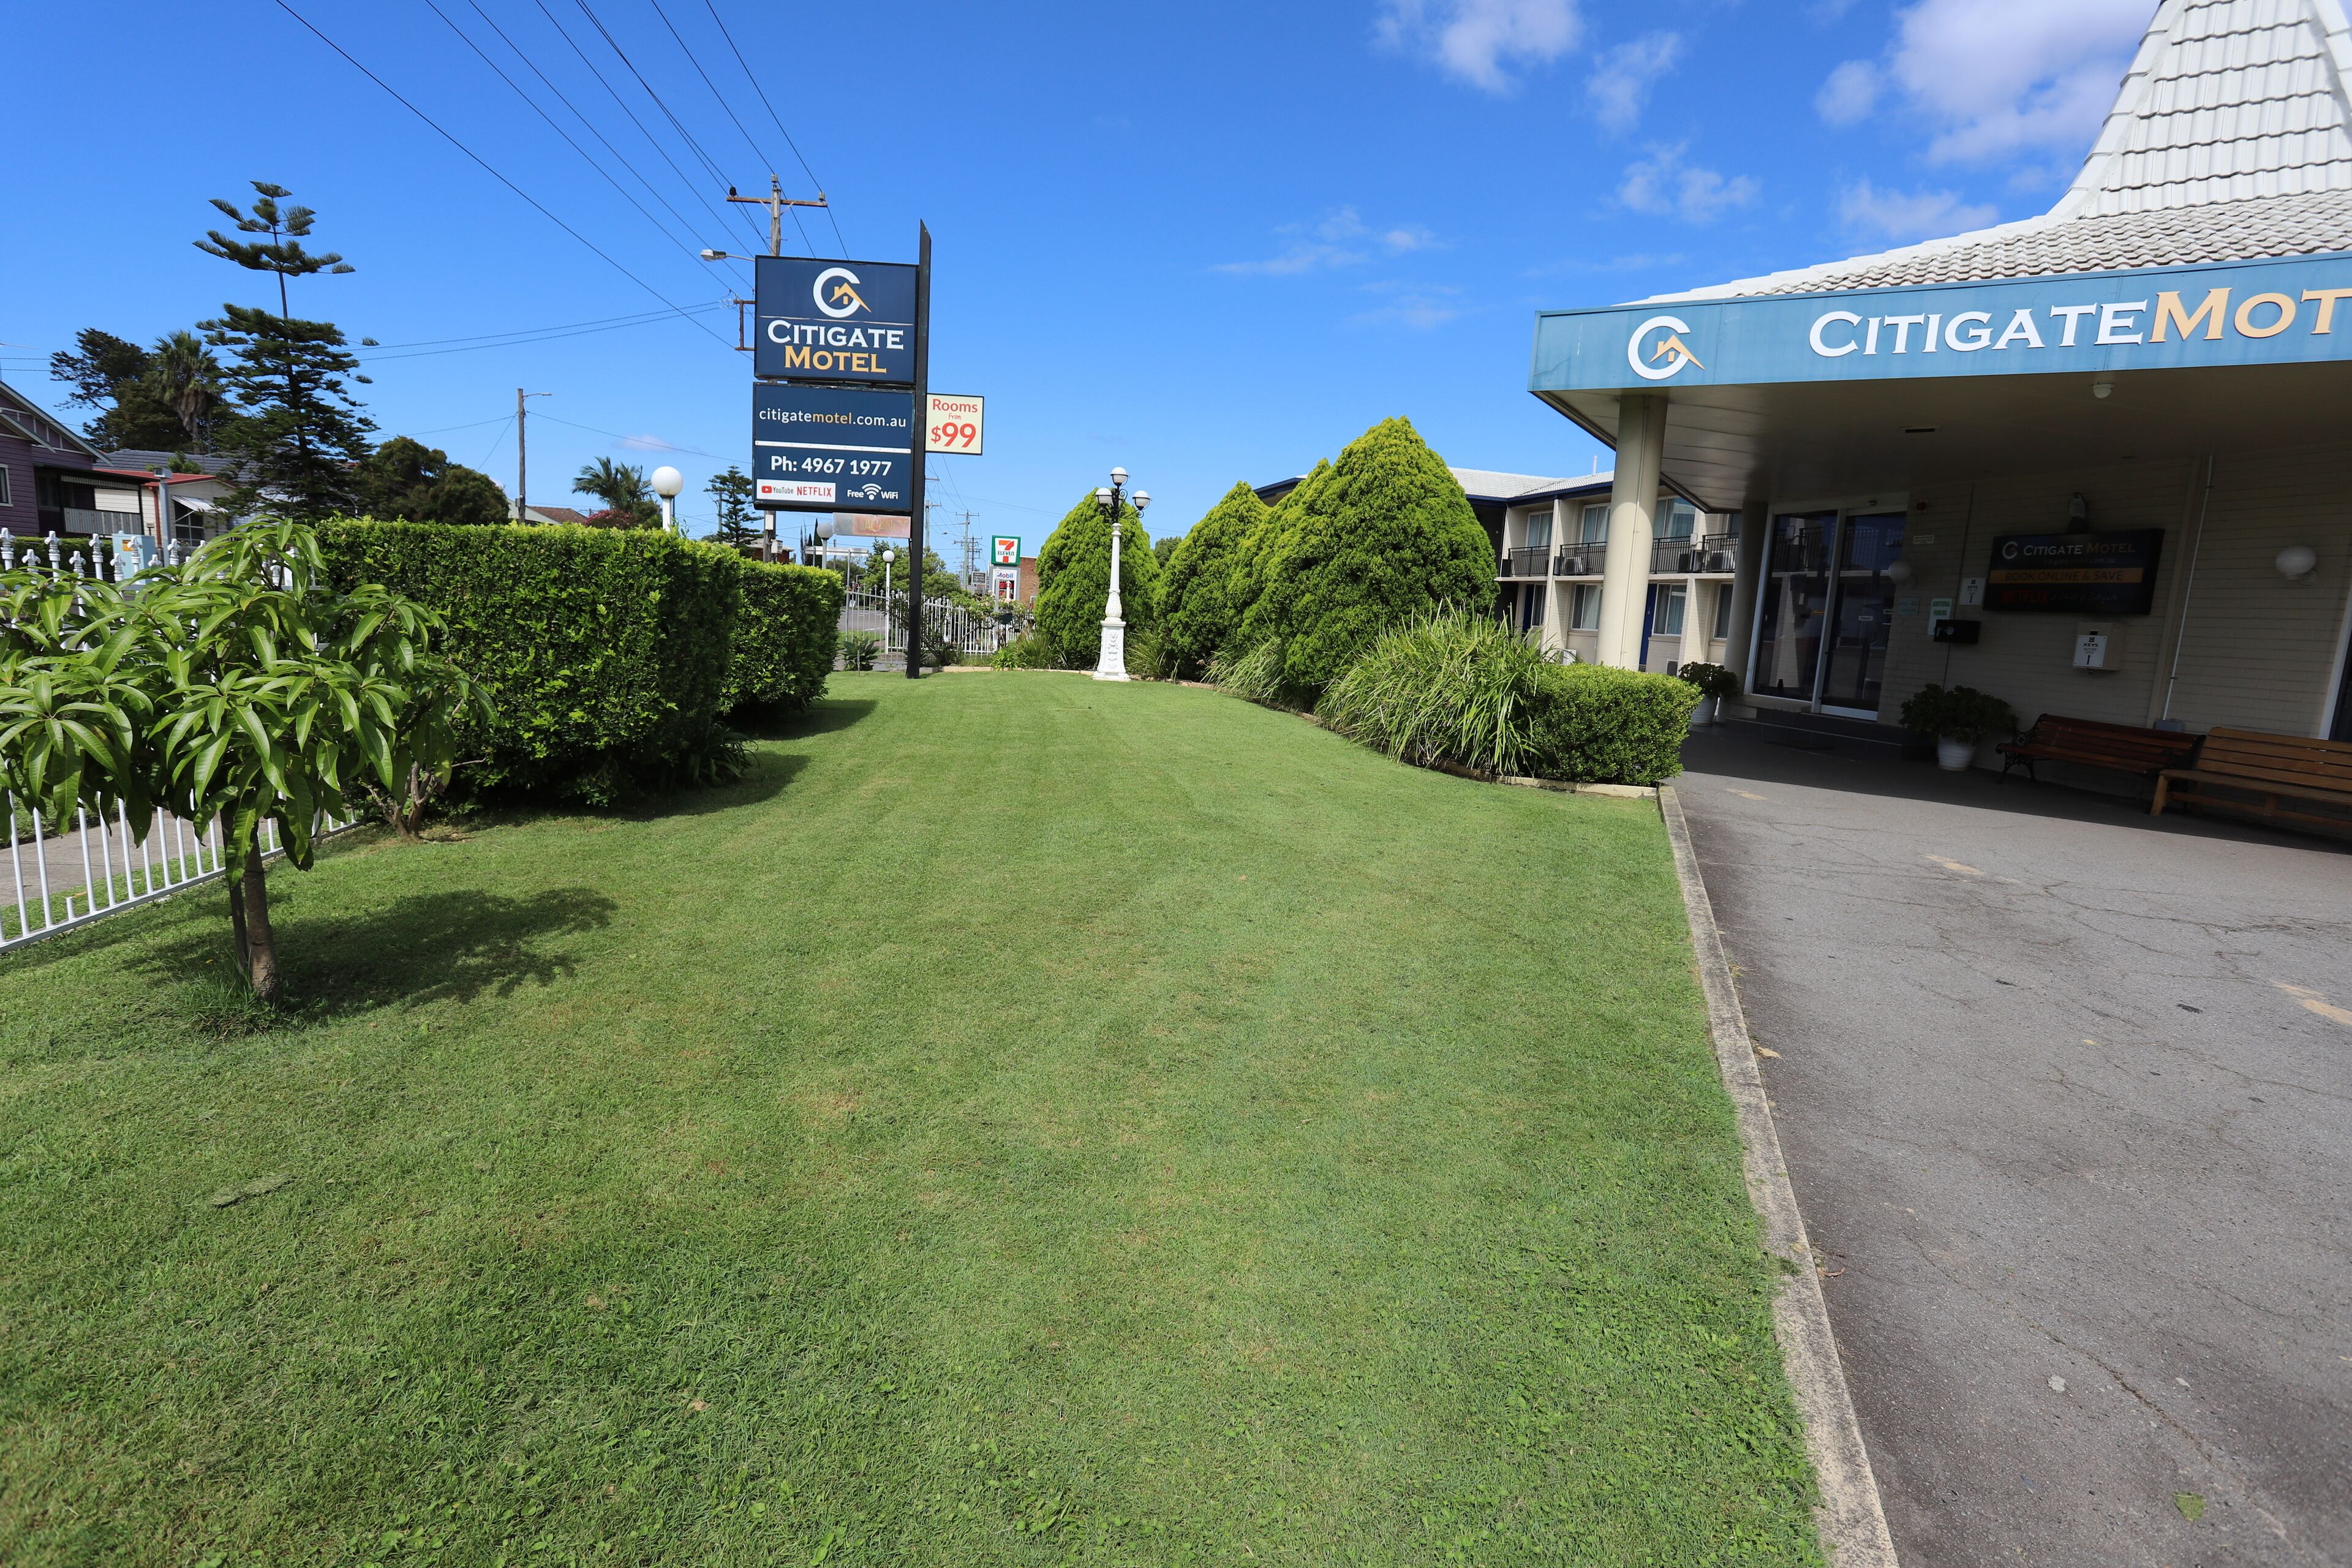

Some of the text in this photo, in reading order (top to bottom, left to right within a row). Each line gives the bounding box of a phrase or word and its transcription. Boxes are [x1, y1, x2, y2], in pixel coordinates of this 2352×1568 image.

[767, 320, 904, 350] CITIGATE
[785, 345, 887, 374] MOTEL
[932, 398, 978, 413] Rooms
[759, 408, 907, 427] citigatemotel.com.au
[930, 422, 977, 448] $99
[771, 456, 892, 476] Ph: 4967 1977
[797, 486, 832, 497] NETFLIX
[847, 489, 864, 498] Free
[2024, 545, 2083, 556] CITIGATE
[2087, 542, 2136, 554] MOTEL
[2005, 572, 2035, 581] BOOK
[2038, 571, 2079, 581] ONLINE
[2094, 571, 2124, 581] SAVE
